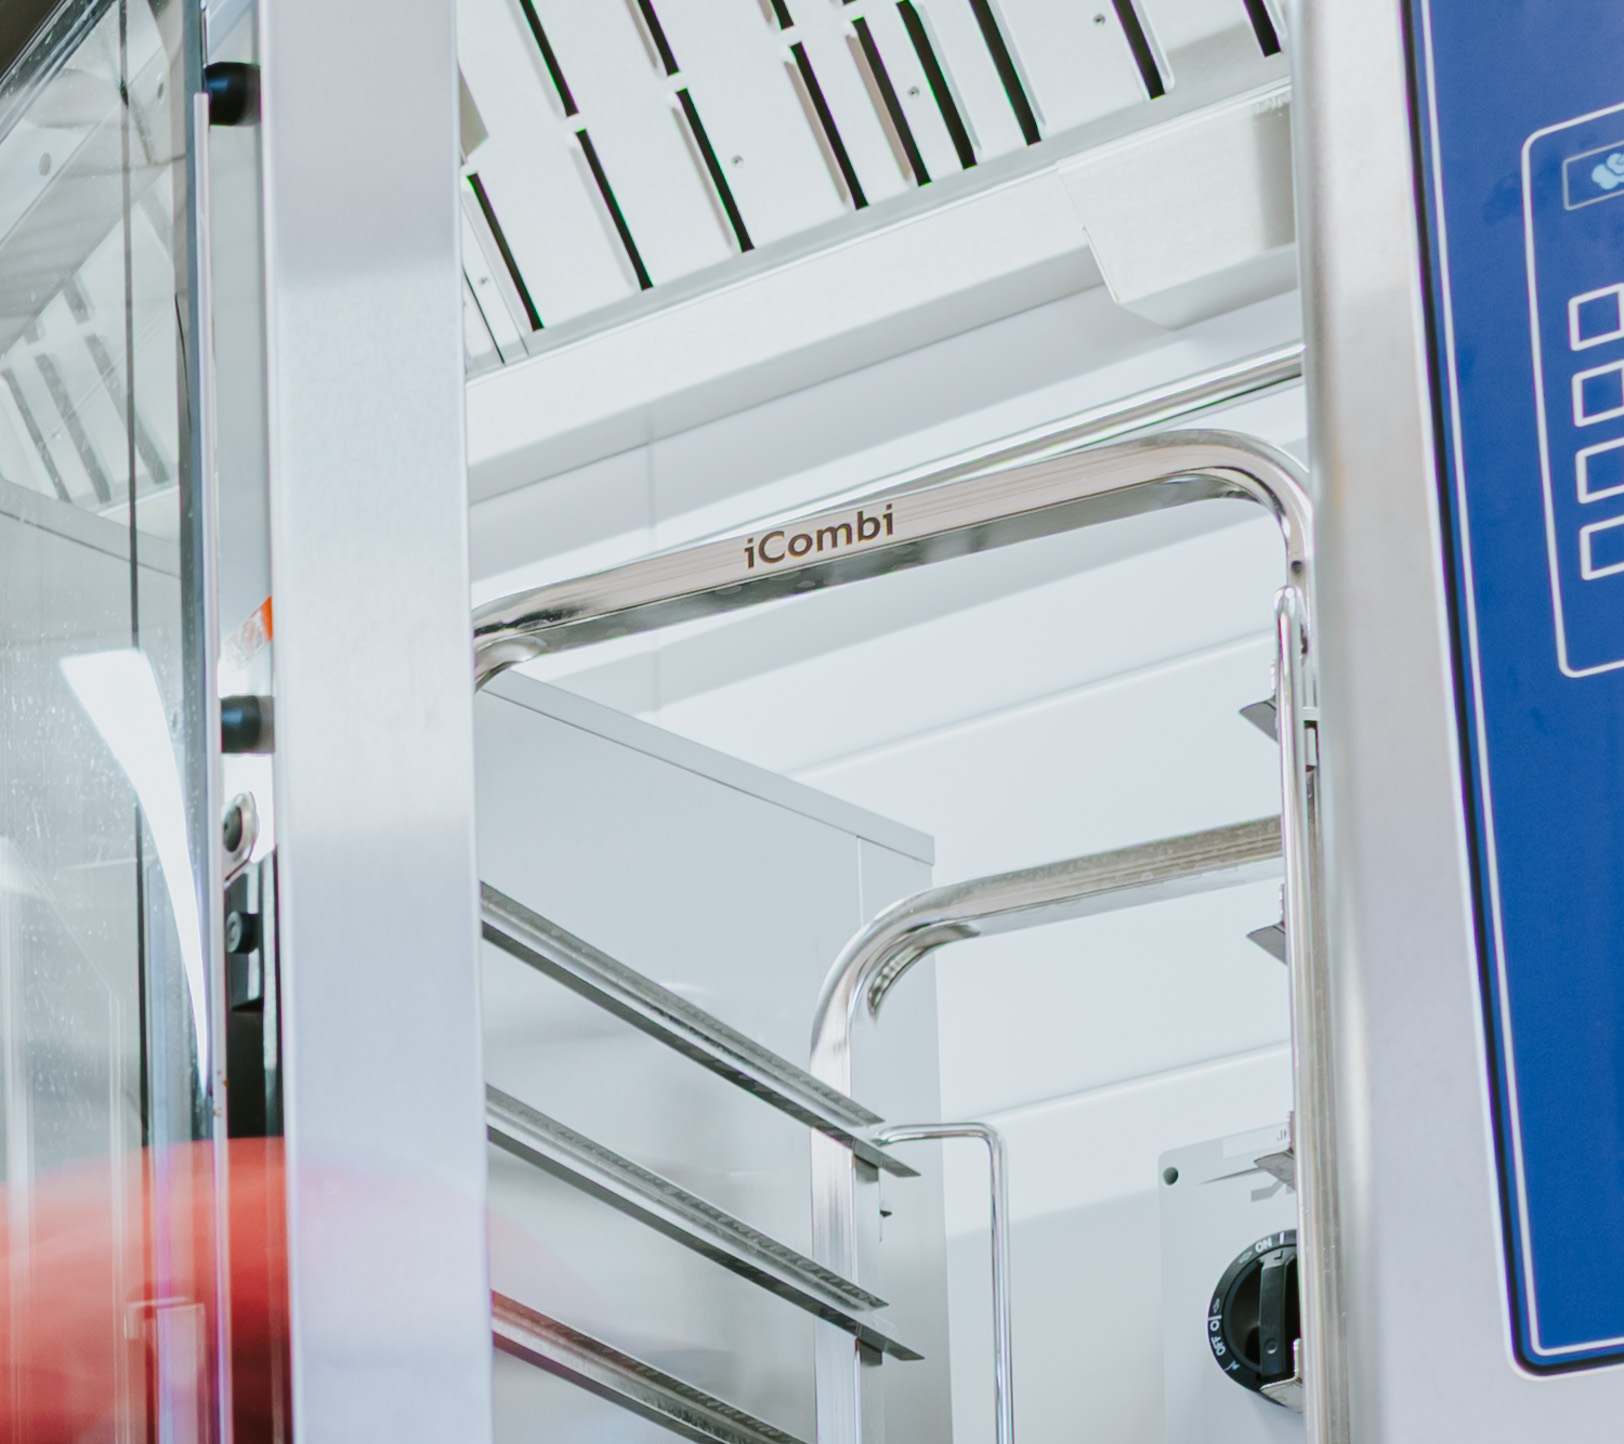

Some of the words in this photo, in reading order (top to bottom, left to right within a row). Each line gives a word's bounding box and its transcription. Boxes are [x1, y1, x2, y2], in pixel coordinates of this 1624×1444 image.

[743, 503, 894, 569] iCombi
[1255, 1237, 1273, 1253] ON
[1209, 1336, 1227, 1357] OFF
